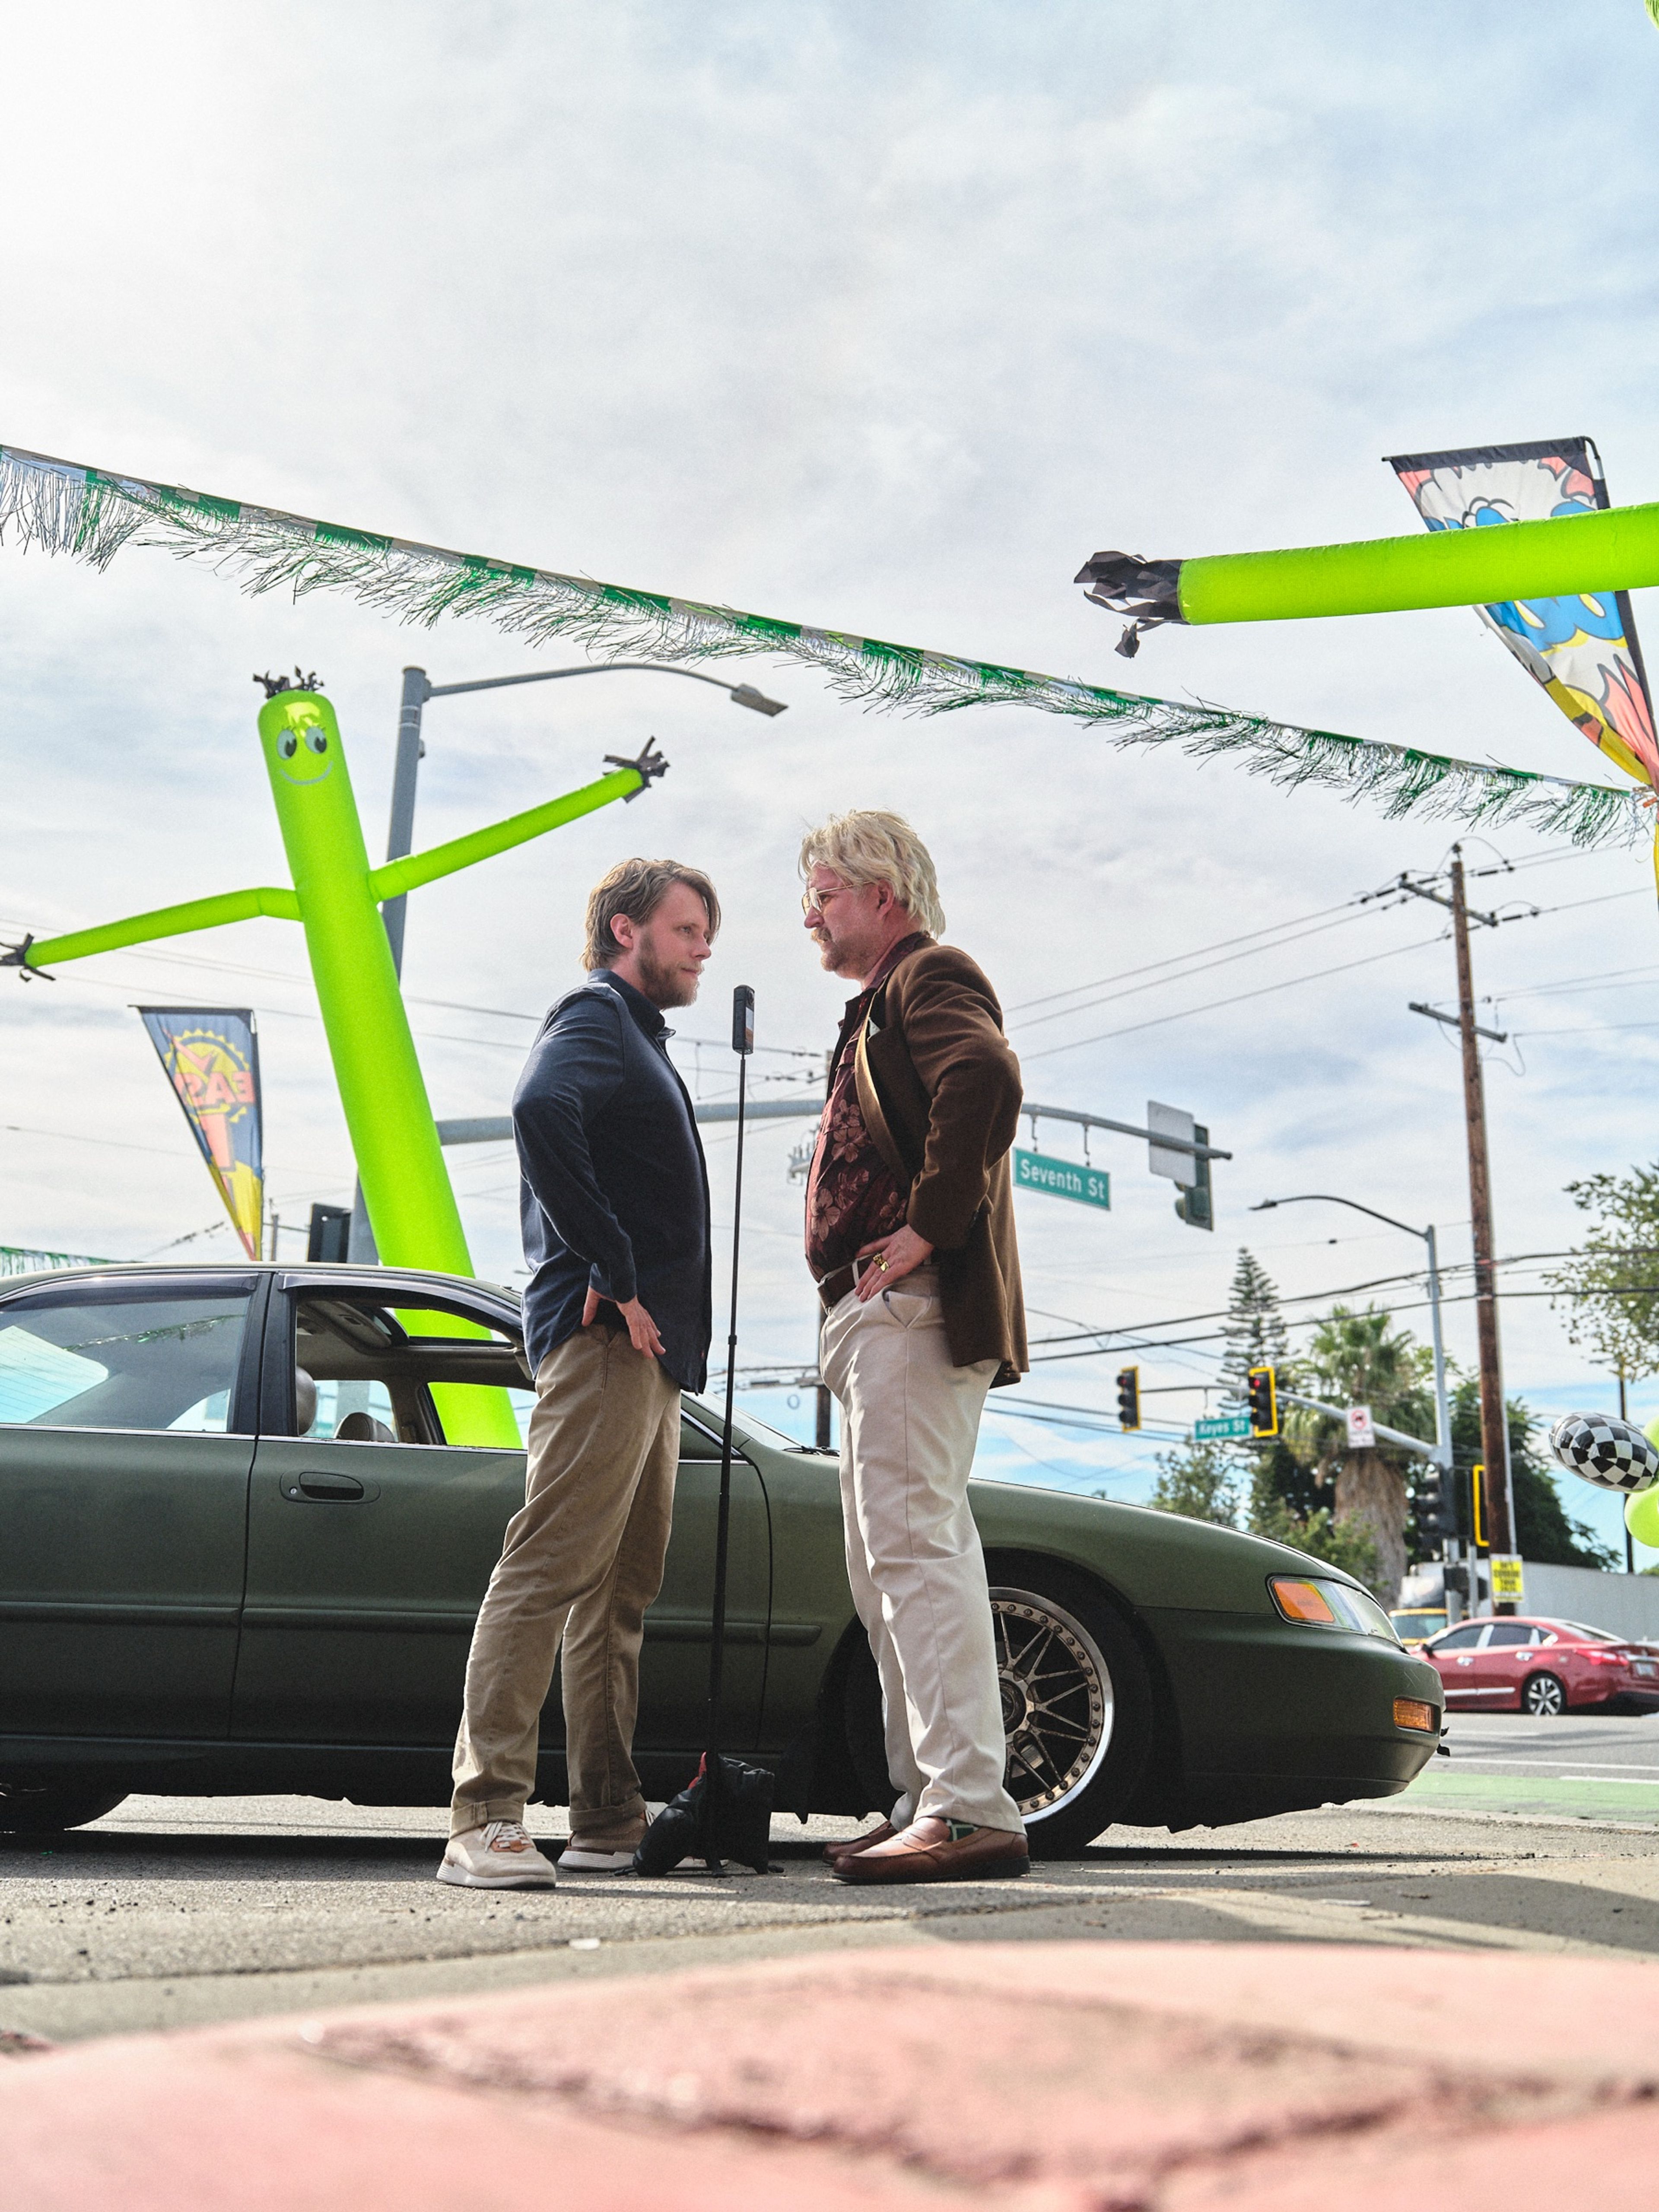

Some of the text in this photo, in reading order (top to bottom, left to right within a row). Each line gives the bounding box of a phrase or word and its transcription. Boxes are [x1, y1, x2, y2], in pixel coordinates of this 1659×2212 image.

[1020, 1158, 1105, 1199] Seventh St
[1199, 1420, 1245, 1436] Keyes St
